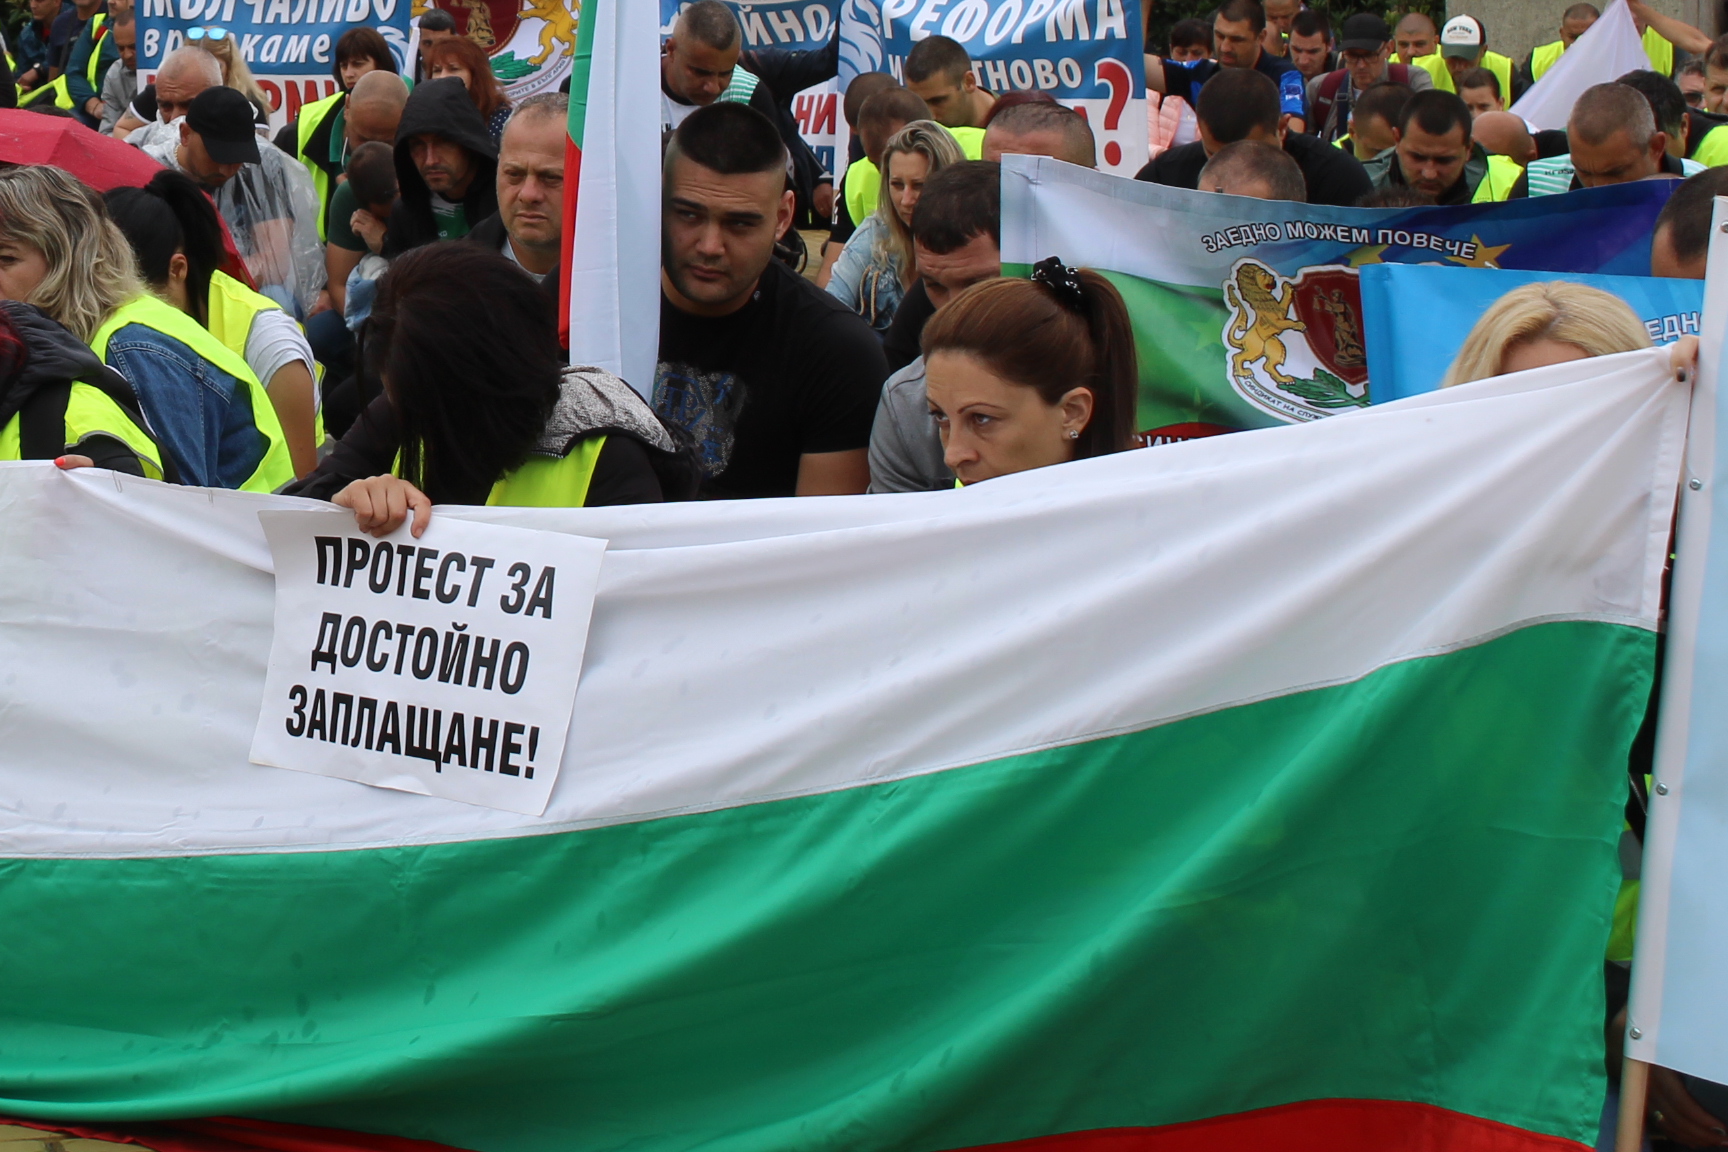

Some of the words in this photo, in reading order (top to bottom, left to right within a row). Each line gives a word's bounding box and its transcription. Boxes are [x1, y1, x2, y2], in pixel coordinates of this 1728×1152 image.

[1201, 222, 1281, 252] ЗАЕДНО
[1285, 220, 1370, 244] МОЖЕМ
[1377, 229, 1477, 260] ПОВЕЧЕ
[1283, 404, 1295, 413] НА
[314, 535, 495, 608] ПРОТЕСТ
[499, 562, 556, 620] ЗА
[311, 611, 530, 694] ДОСТОЙНО
[286, 684, 540, 779] ЗАПЛАЩАНЕ!
